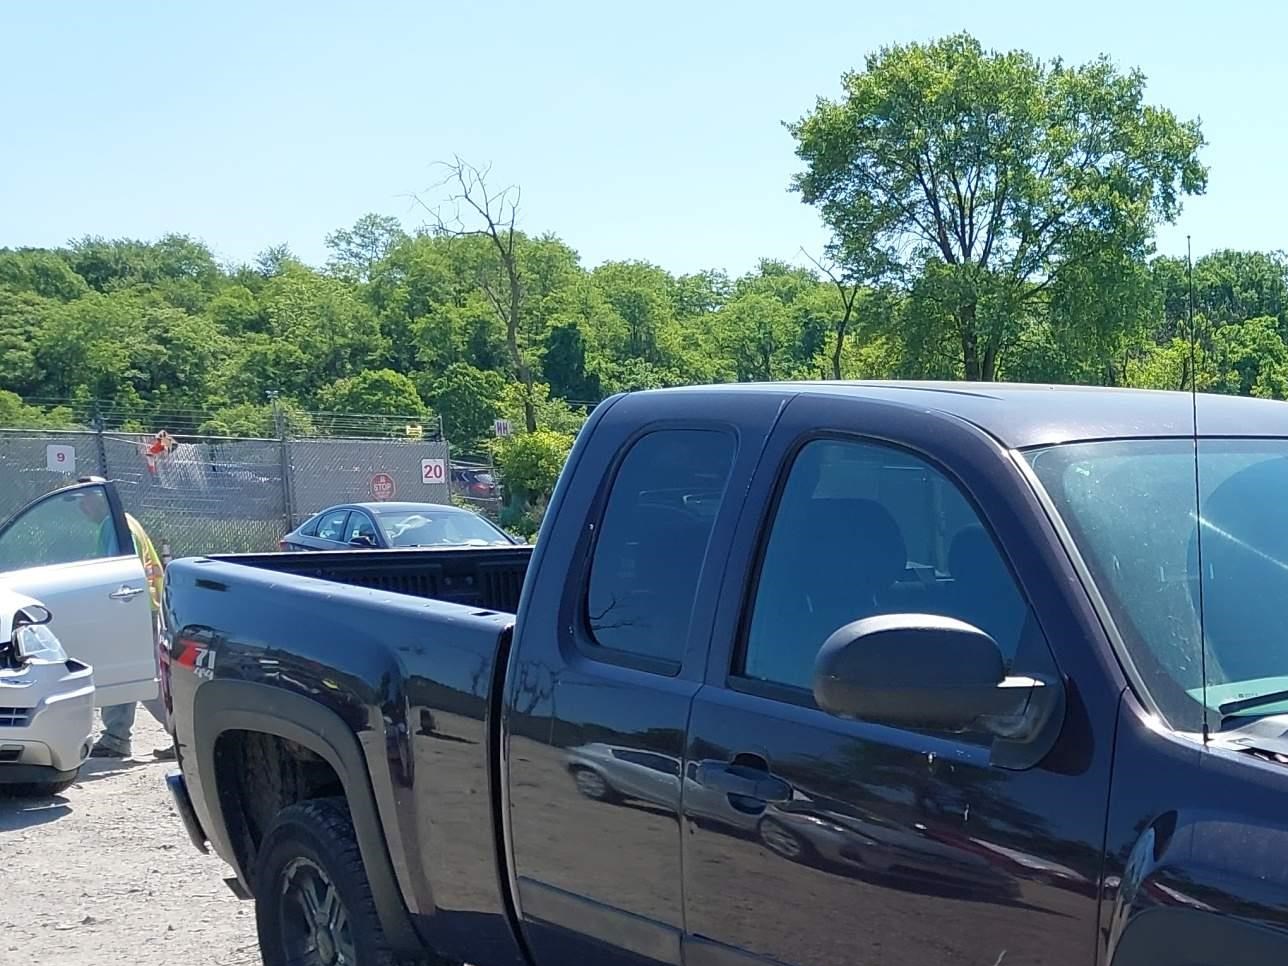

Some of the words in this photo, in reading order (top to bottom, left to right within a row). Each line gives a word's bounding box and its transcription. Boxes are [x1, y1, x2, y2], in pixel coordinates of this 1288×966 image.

[56, 452, 65, 462] 9
[423, 464, 443, 479] 20
[373, 482, 392, 492] STOP
